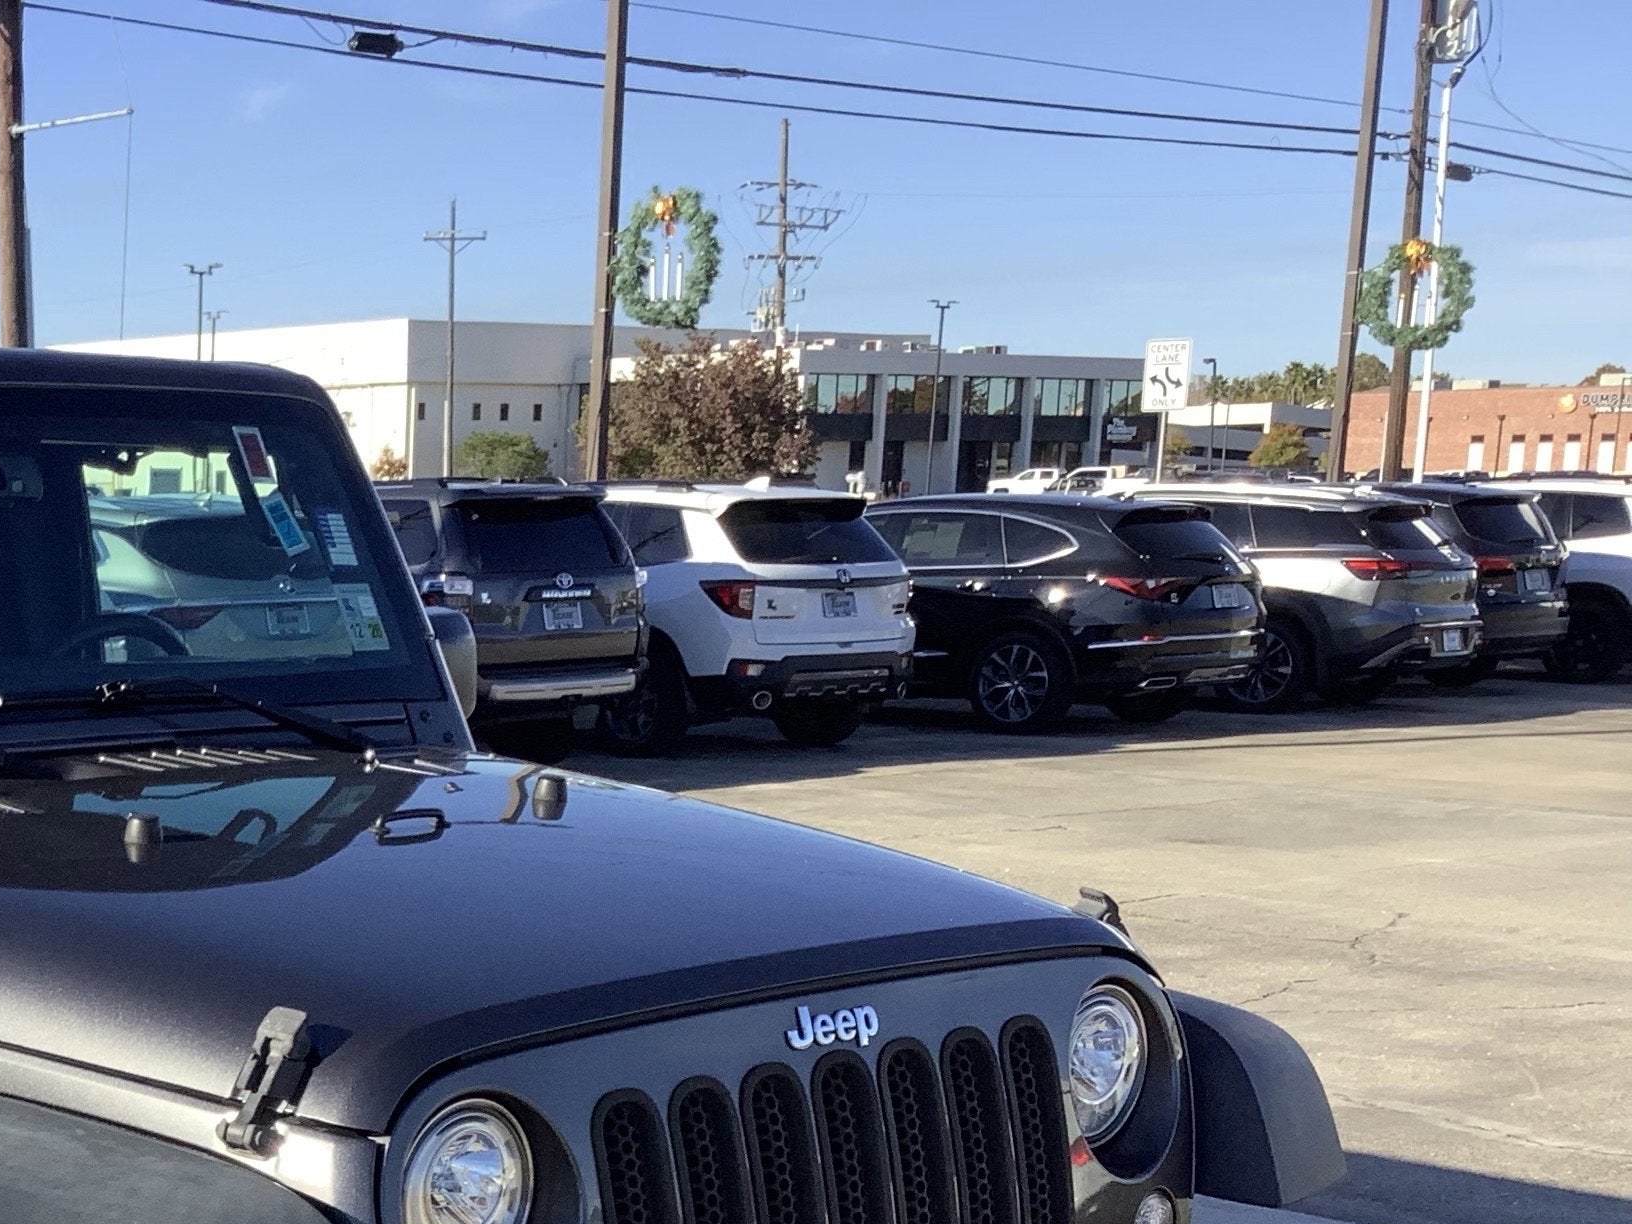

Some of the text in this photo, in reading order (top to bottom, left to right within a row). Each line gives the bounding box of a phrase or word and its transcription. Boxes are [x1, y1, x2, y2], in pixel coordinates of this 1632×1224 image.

[1151, 343, 1187, 353] CENTER
[1155, 353, 1180, 363] LANE
[1151, 398, 1177, 407] ONLY
[350, 623, 364, 639] 12
[787, 1005, 879, 1050] Jeep
